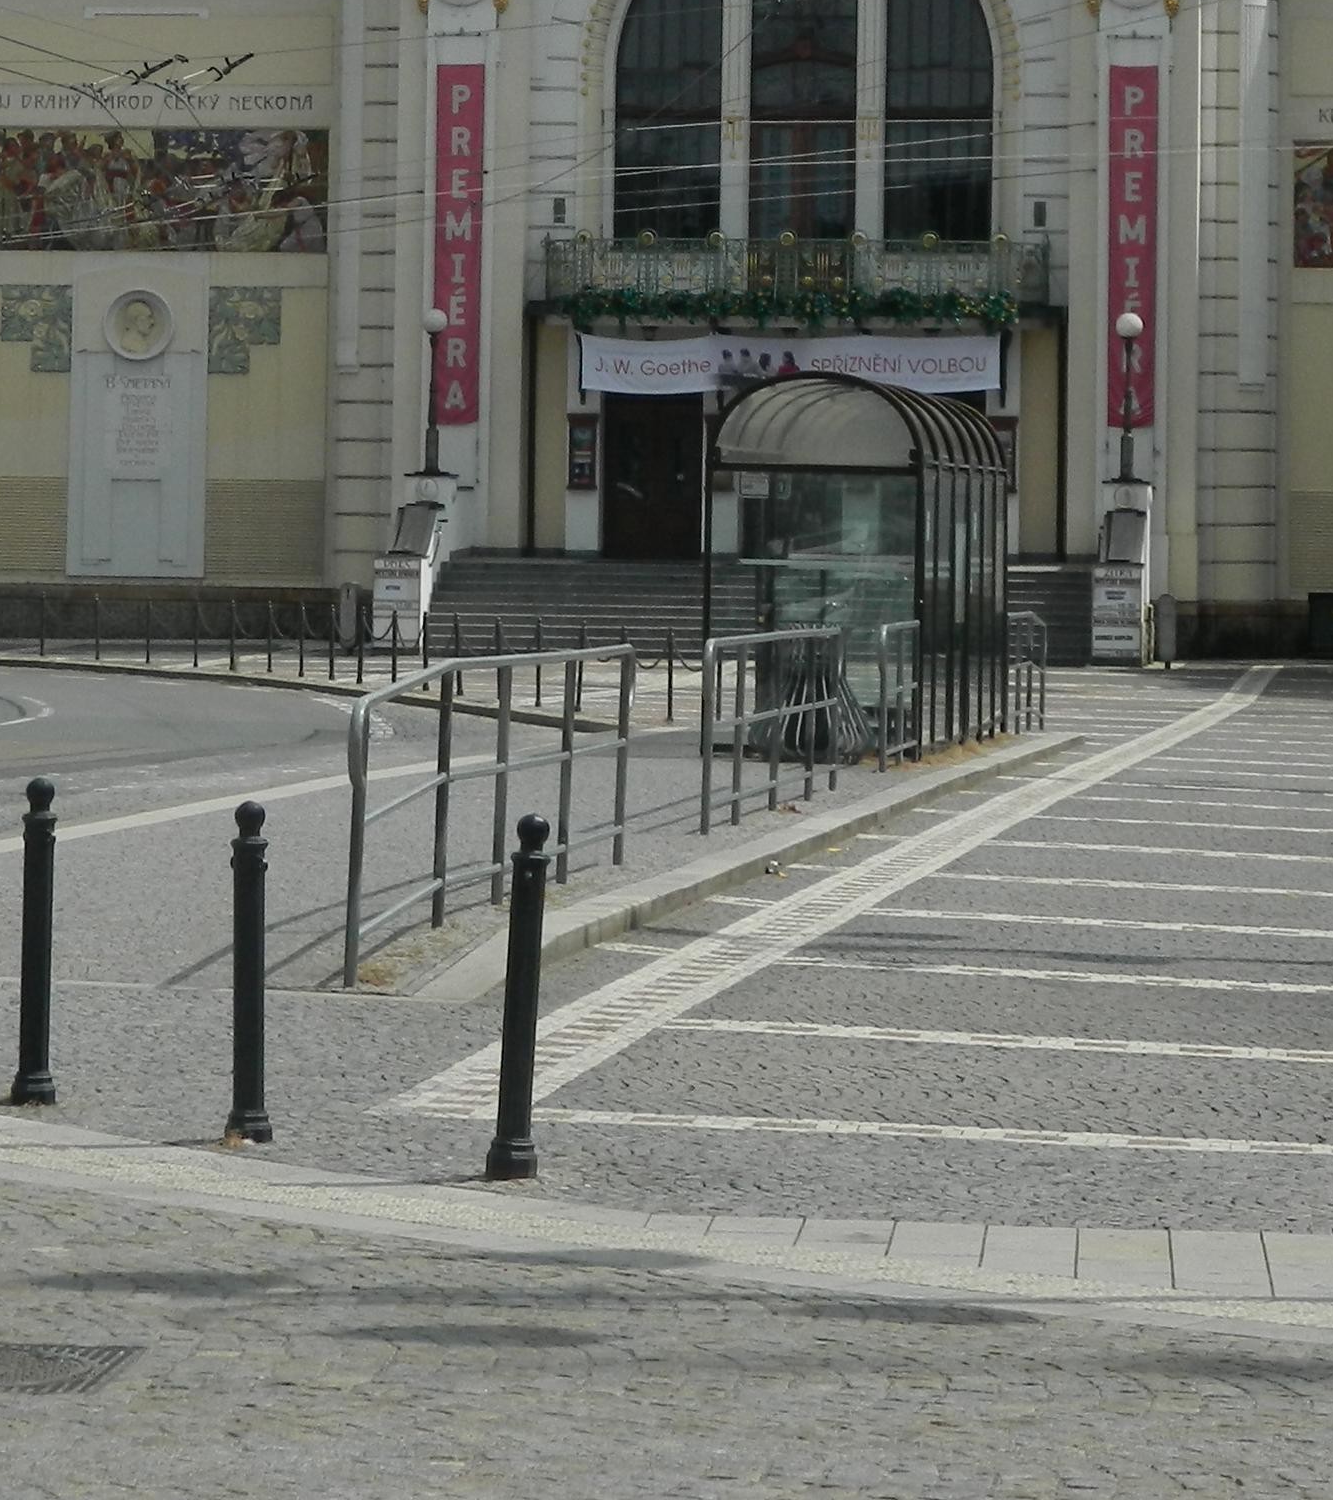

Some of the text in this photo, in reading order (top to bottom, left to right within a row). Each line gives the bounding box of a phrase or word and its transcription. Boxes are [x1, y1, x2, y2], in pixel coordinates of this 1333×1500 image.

[444, 84, 472, 410] PREMIÉRA
[594, 356, 712, 376] J. W. Goethe
[810, 353, 988, 374] SPŘÍZNĚNÍ VOLBOU
